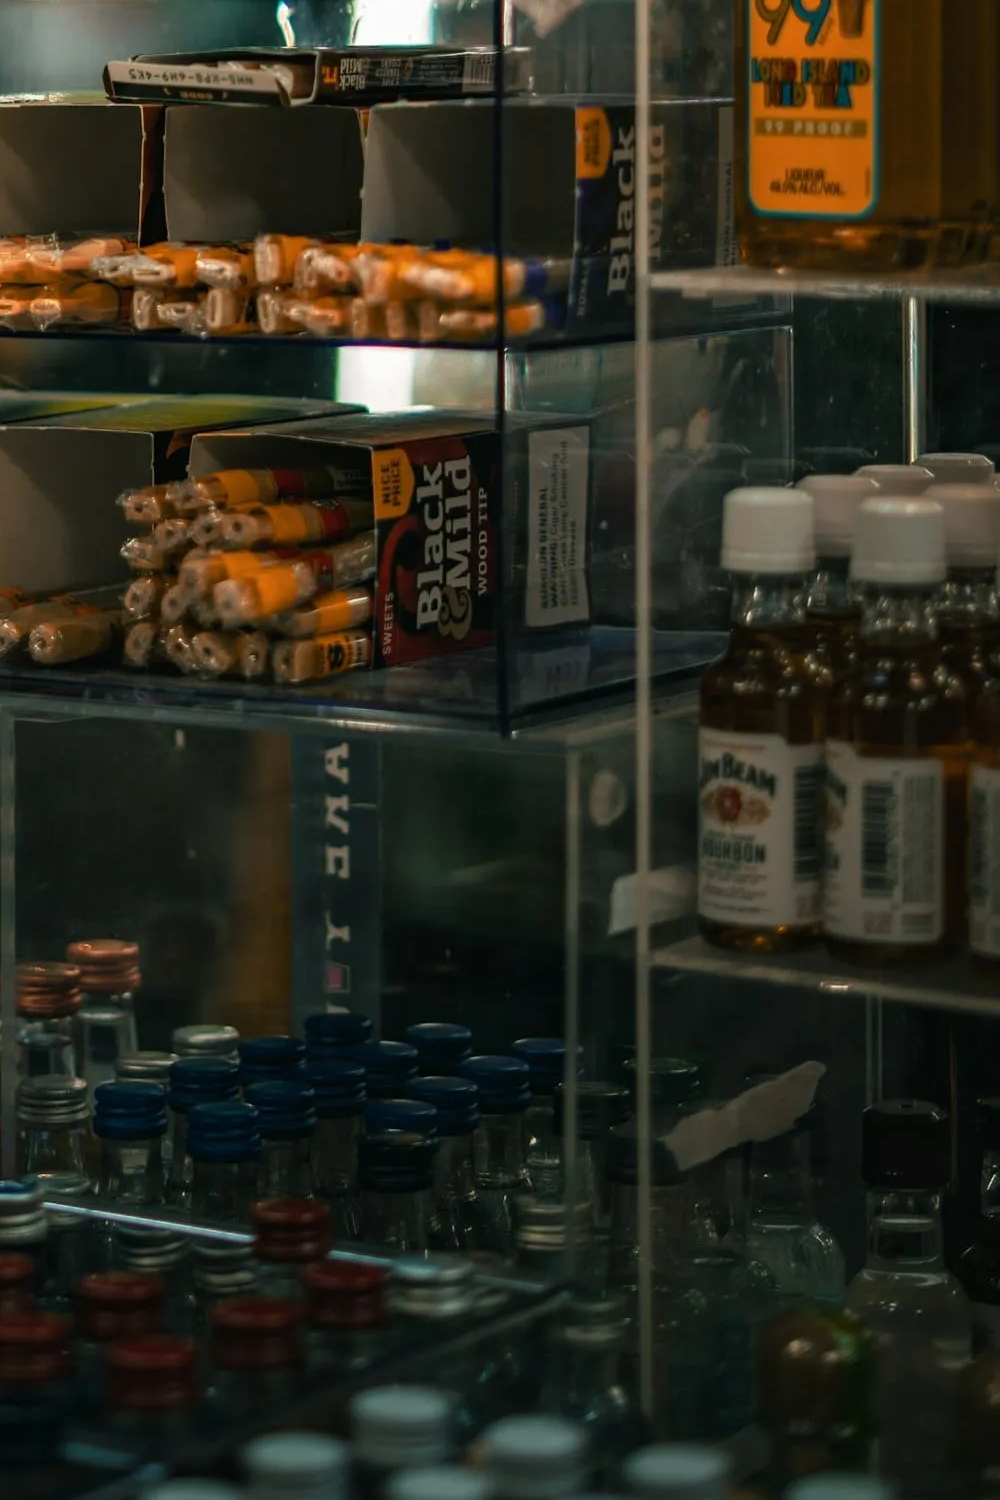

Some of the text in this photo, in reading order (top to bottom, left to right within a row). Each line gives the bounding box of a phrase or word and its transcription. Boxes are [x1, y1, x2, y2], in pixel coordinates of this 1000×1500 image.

[339, 75, 366, 90] Black
[340, 58, 362, 74] Mild
[607, 125, 635, 296] Black
[382, 463, 390, 505] NICE
[391, 457, 400, 507] PRICE
[416, 461, 444, 631] Black
[445, 455, 471, 590] Mild
[478, 487, 488, 597] WOOD TIP
[382, 592, 394, 657] SWEETS
[722, 753, 777, 800] BEAM
